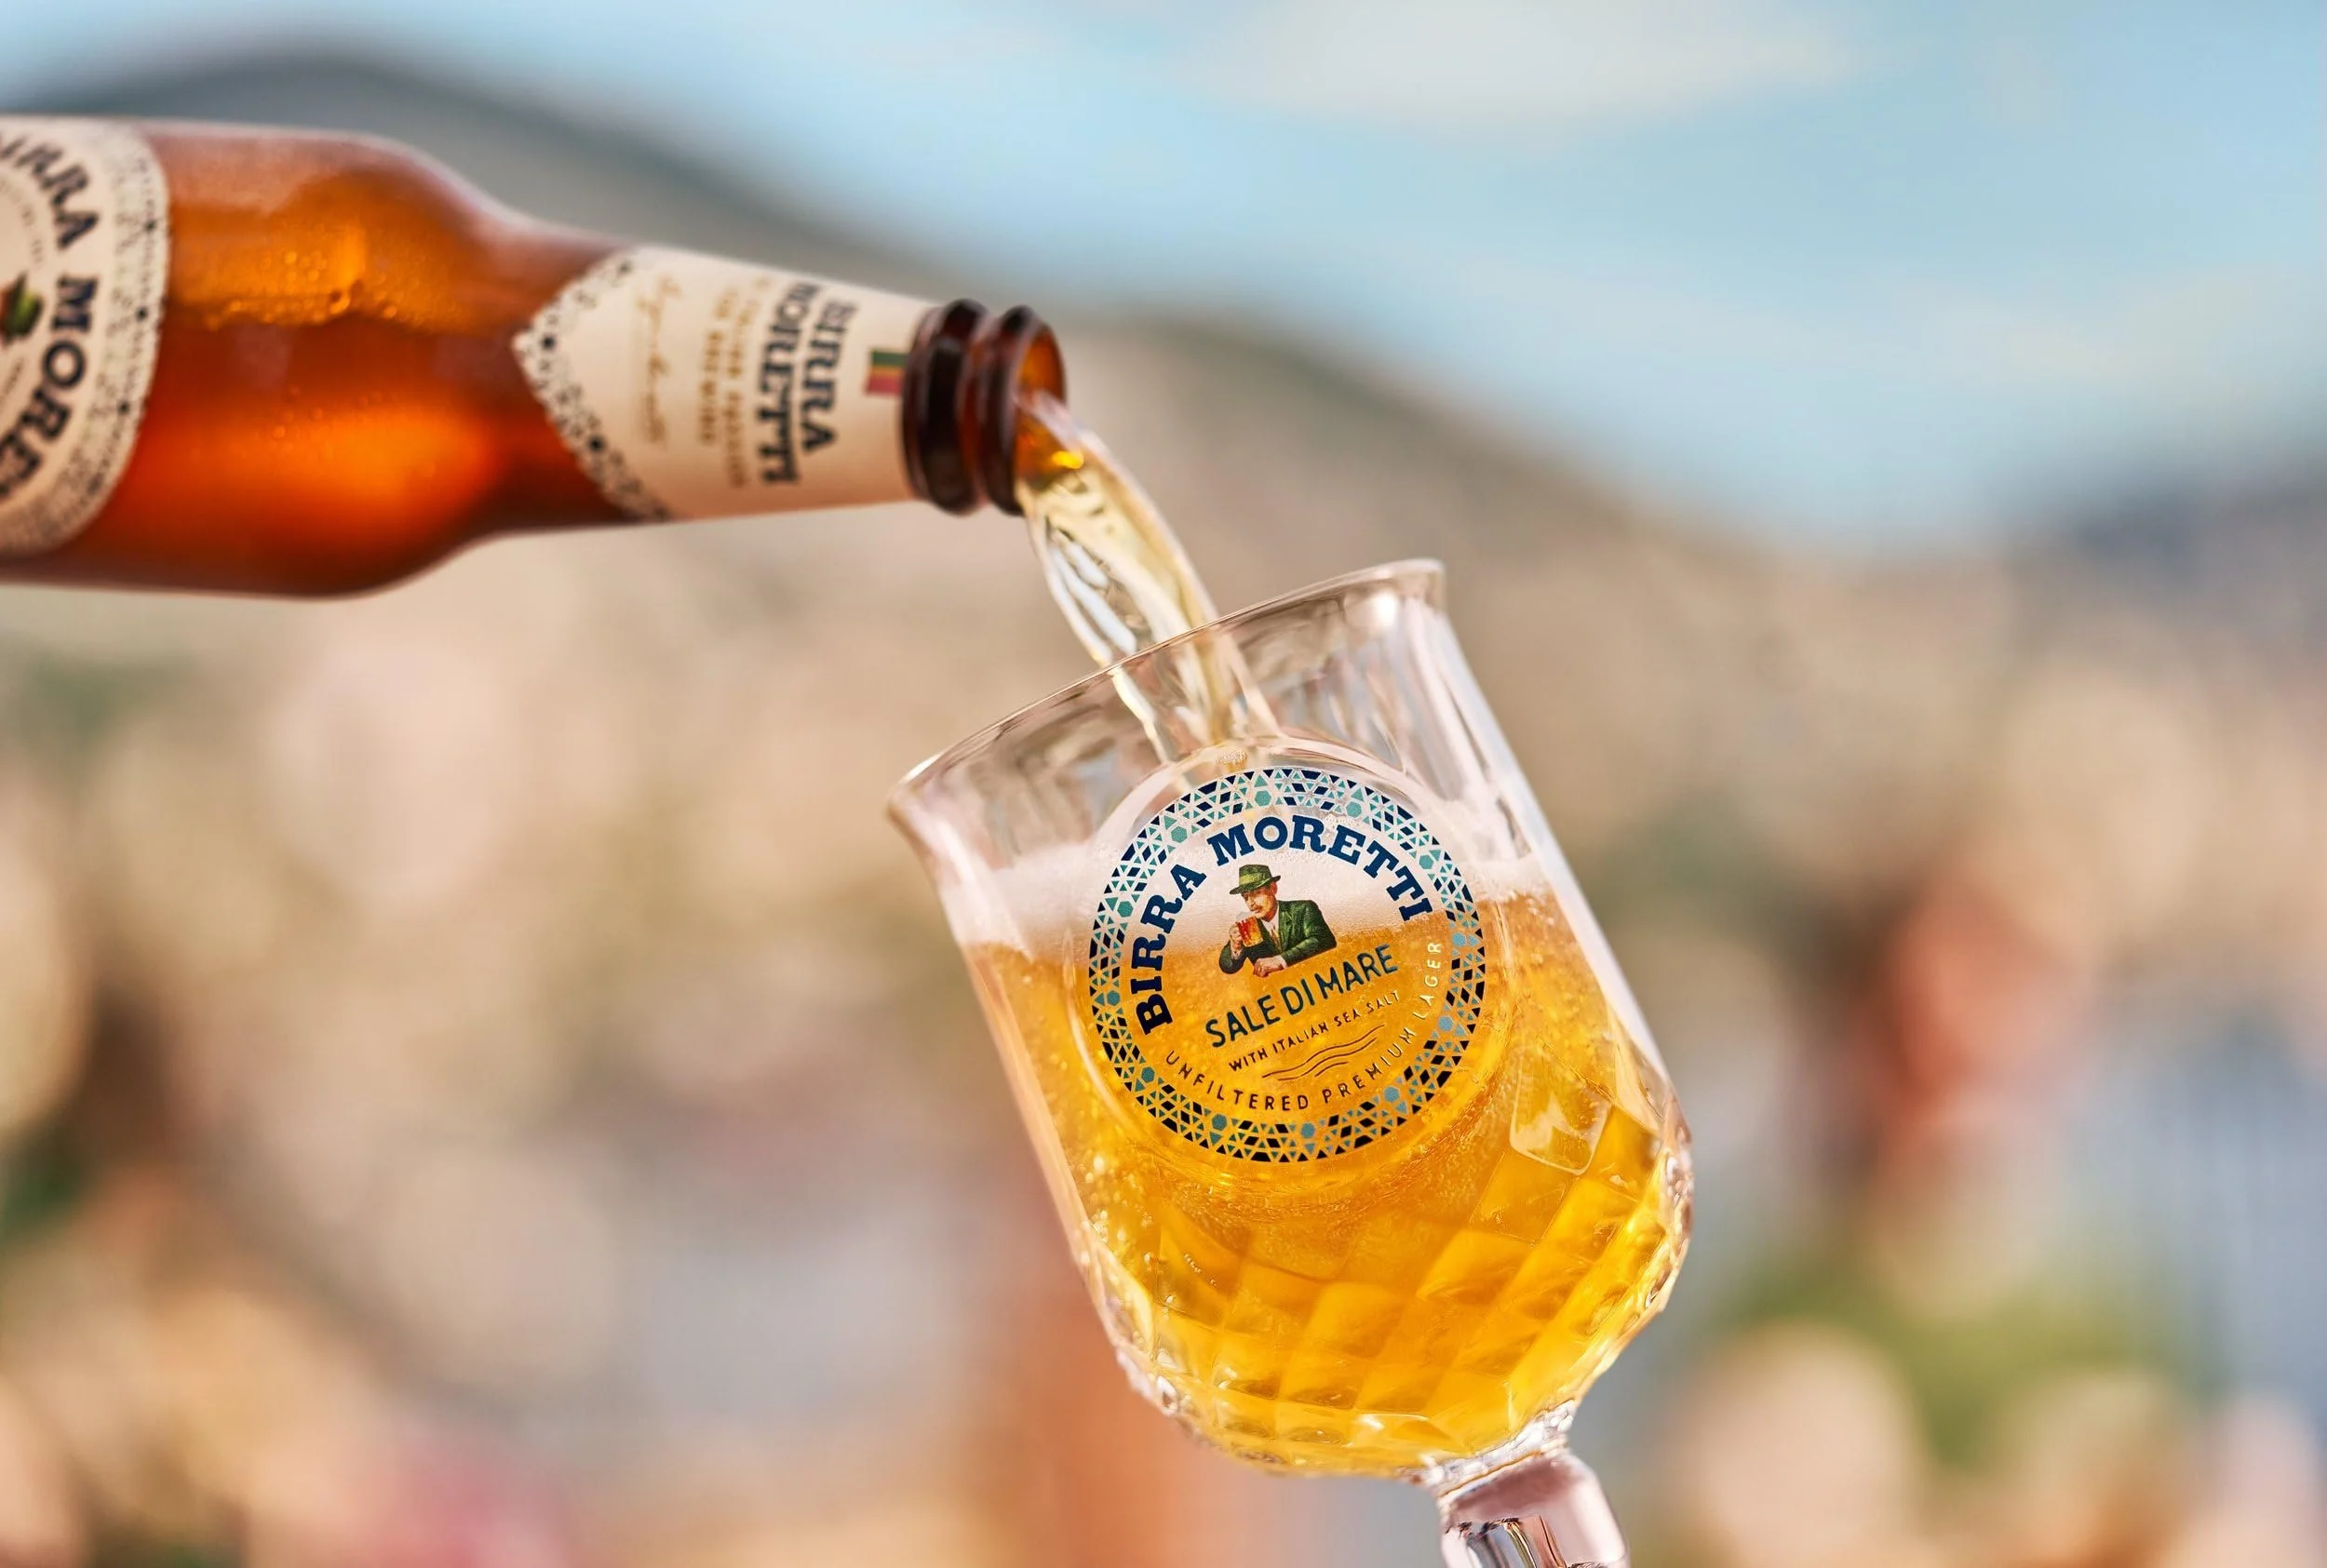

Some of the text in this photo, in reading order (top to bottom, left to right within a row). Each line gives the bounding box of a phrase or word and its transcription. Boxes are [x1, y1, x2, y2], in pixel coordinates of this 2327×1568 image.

[0, 136, 101, 249] IRRA
[0, 274, 99, 499] MORE
[755, 281, 820, 485] MORETTI
[800, 297, 858, 455] BIRRA
[1130, 814, 1434, 1036] BIRRA MORETTI
[1205, 944, 1399, 1048] SALE DI MARE
[1165, 941, 1444, 1112] UNFILTERED PREMIUM LAGER
[1229, 989, 1402, 1073] WITH ITALIAN SEA SALT
